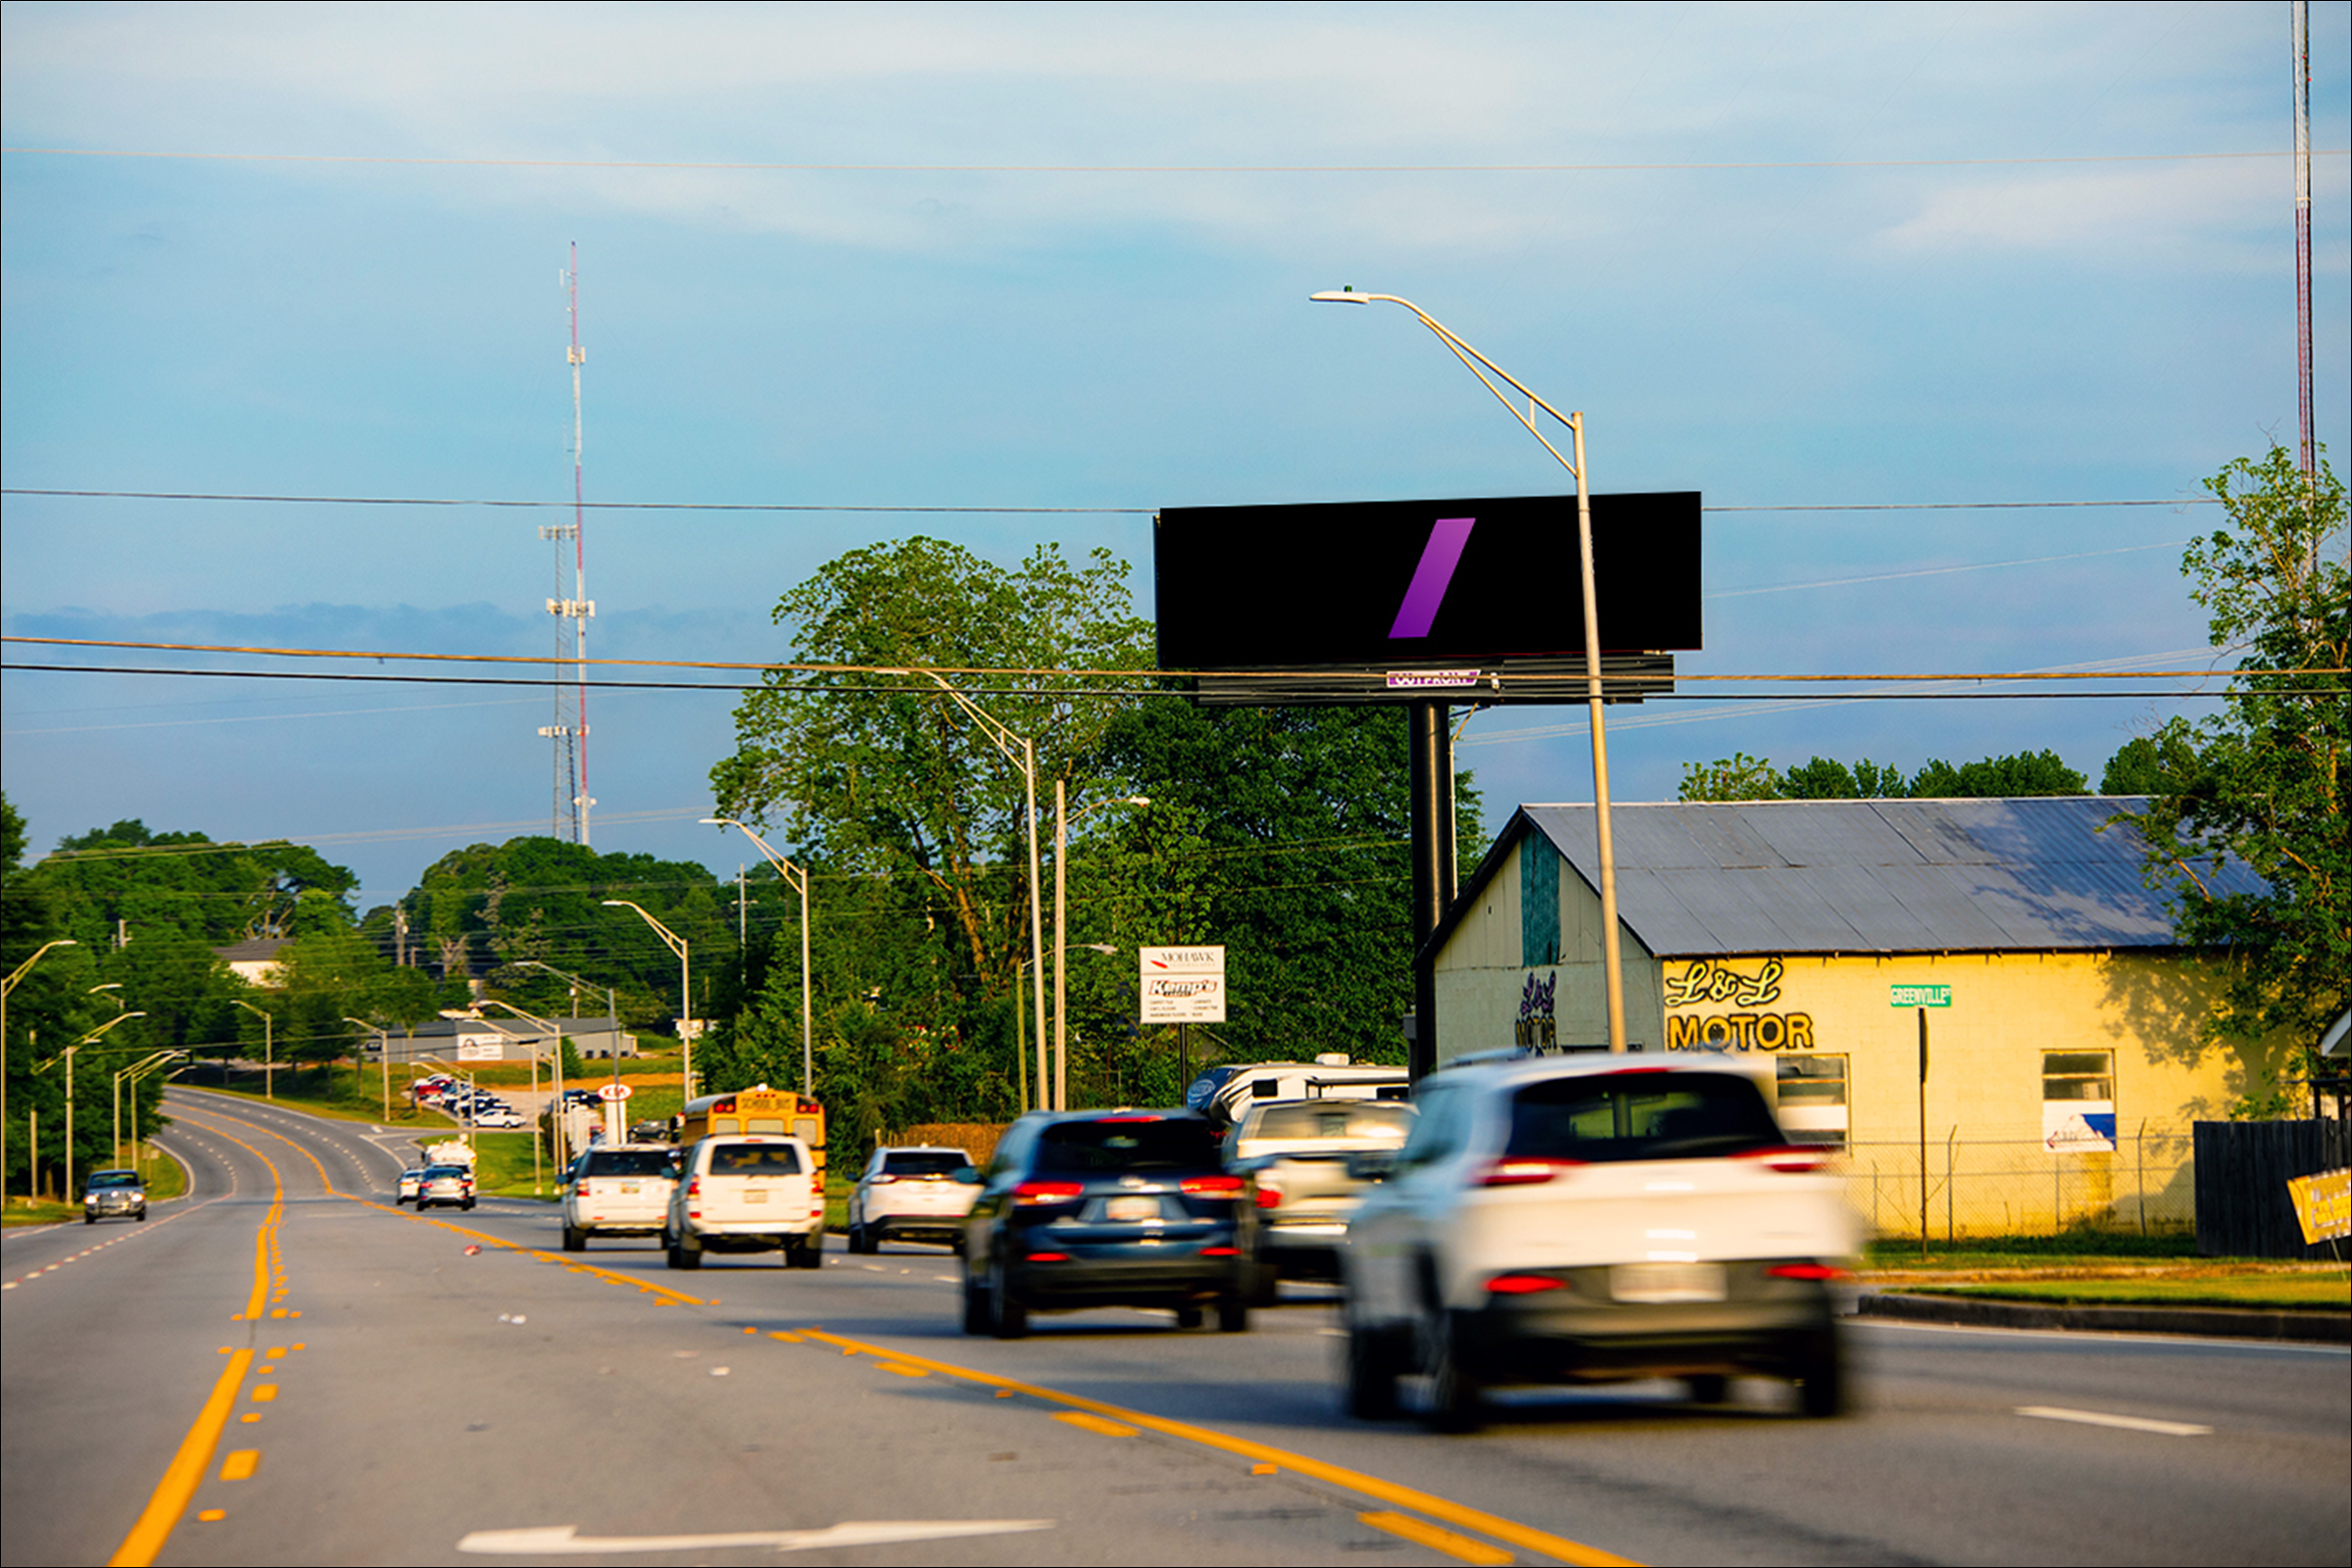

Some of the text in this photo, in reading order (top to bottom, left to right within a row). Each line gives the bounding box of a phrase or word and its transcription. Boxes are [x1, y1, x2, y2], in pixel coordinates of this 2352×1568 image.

[1161, 952, 1214, 962] MOHAWK
[1665, 959, 1783, 1007] L&L
[1890, 988, 1946, 1004] GREENVILLE
[1515, 1014, 1557, 1052] MOTOR
[1667, 1012, 1815, 1052] MOTOR
